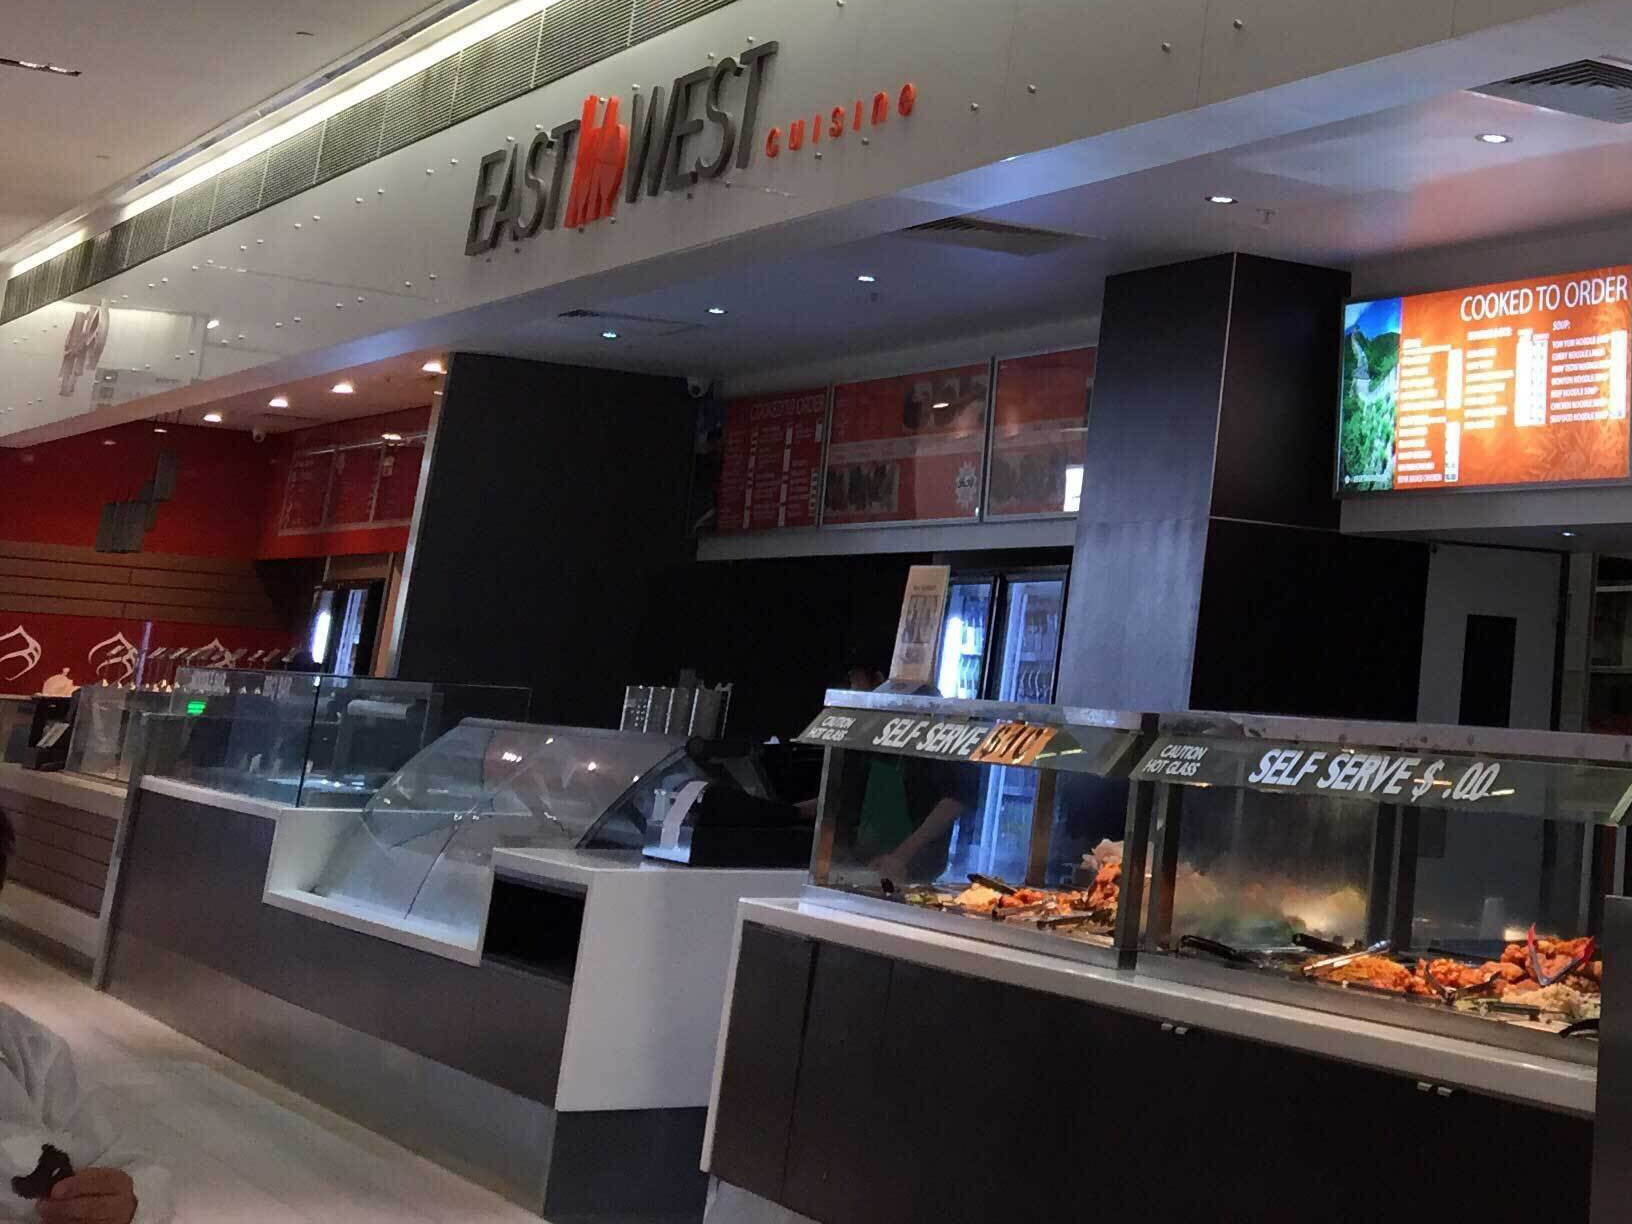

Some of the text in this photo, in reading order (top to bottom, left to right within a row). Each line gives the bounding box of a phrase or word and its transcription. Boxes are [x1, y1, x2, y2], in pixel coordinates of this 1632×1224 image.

[464, 118, 581, 257] EAST
[624, 39, 779, 205] WEST
[1459, 274, 1629, 322] COOKED TO ORDER
[872, 717, 929, 749] SELF
[915, 721, 990, 756] SERVE
[1141, 744, 1209, 777] CAUTION HOT GLASS
[1248, 747, 1326, 787] SELF
[1321, 752, 1421, 796] SERVE
